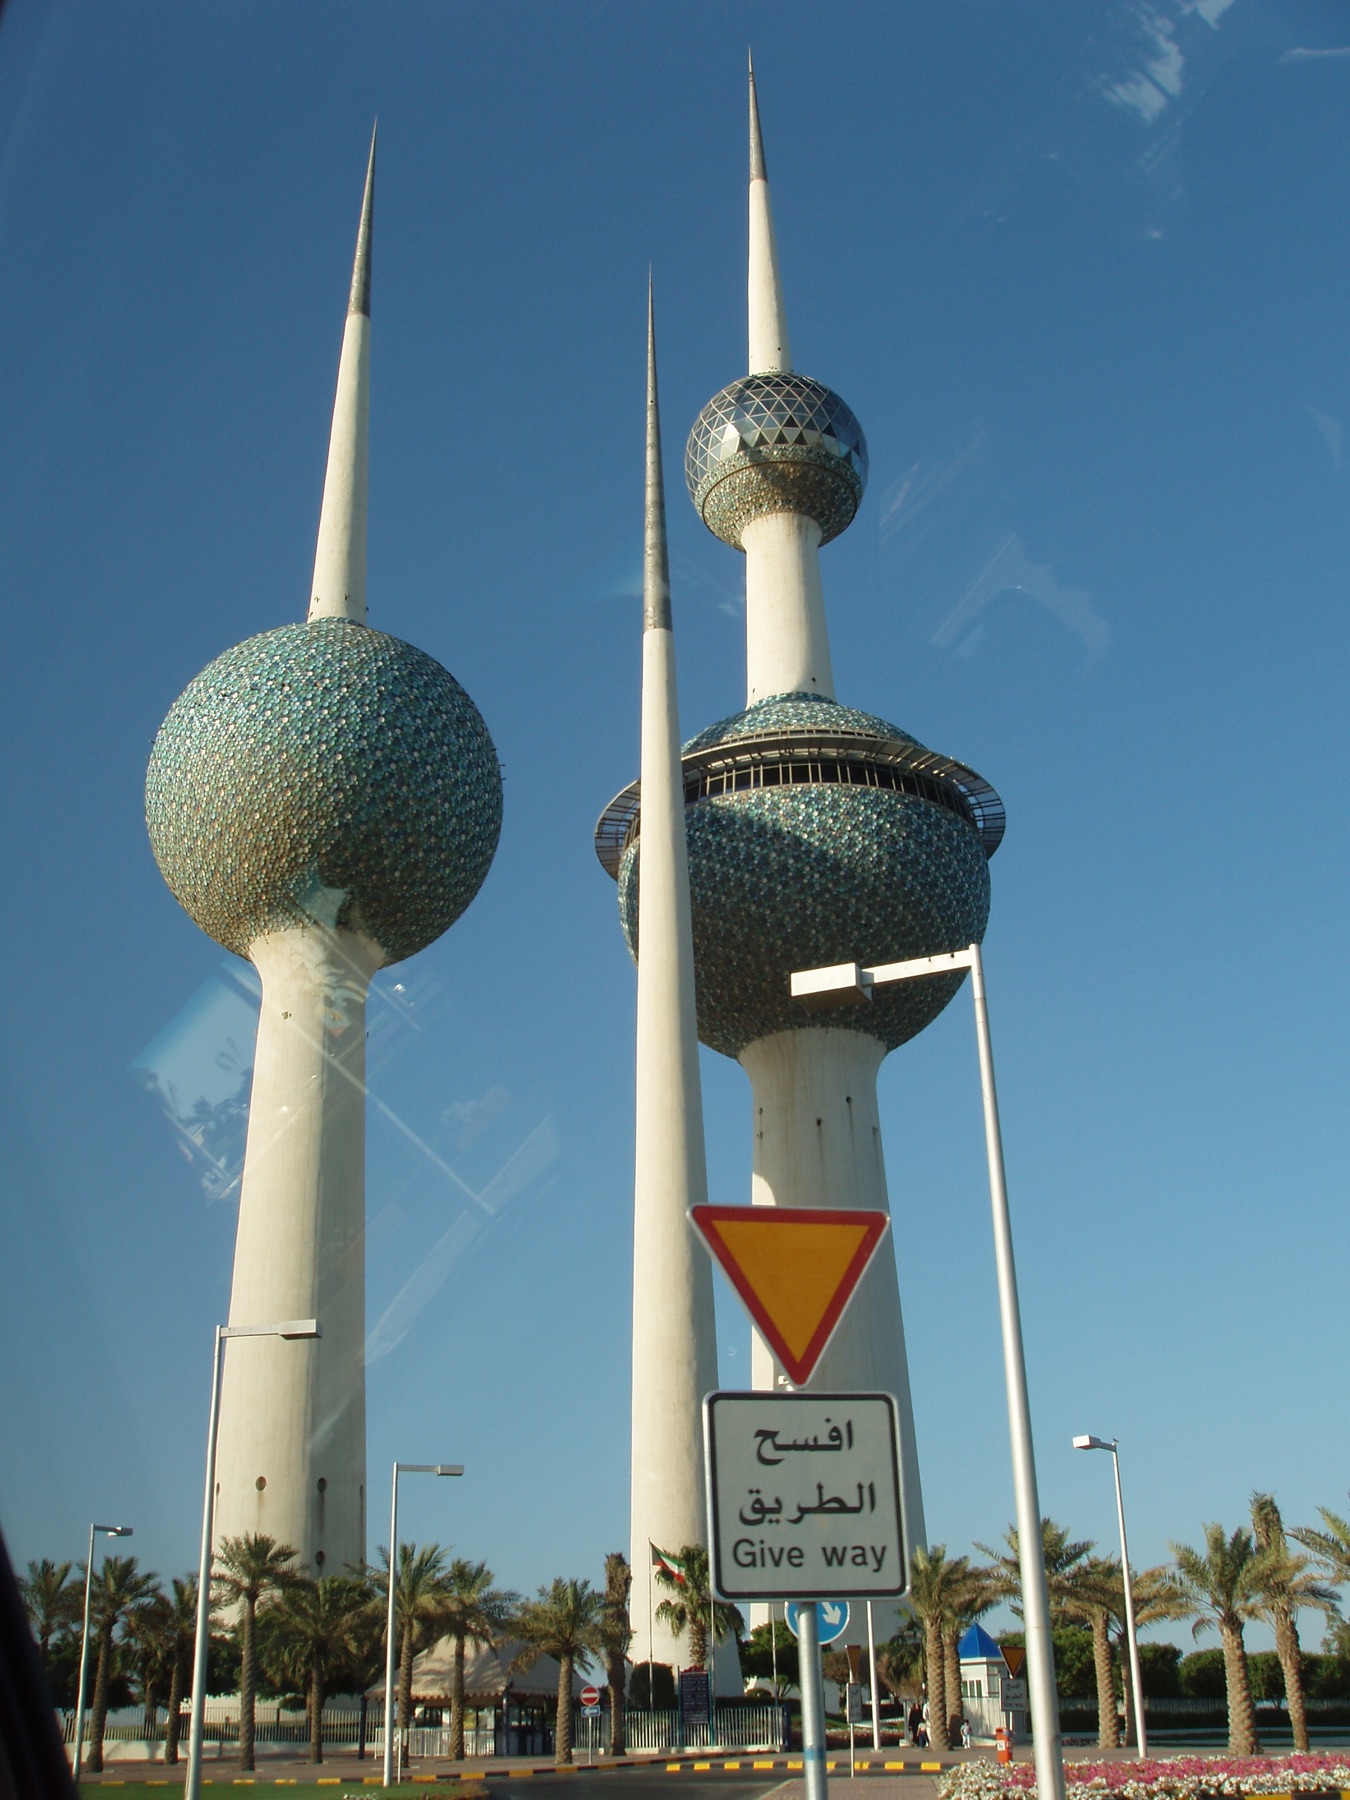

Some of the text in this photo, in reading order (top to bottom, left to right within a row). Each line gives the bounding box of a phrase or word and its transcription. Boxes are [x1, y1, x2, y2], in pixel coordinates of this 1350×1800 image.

[754, 1417, 854, 1466] افسح
[739, 1481, 876, 1527] الطريق
[732, 1538, 887, 1573] Give way
